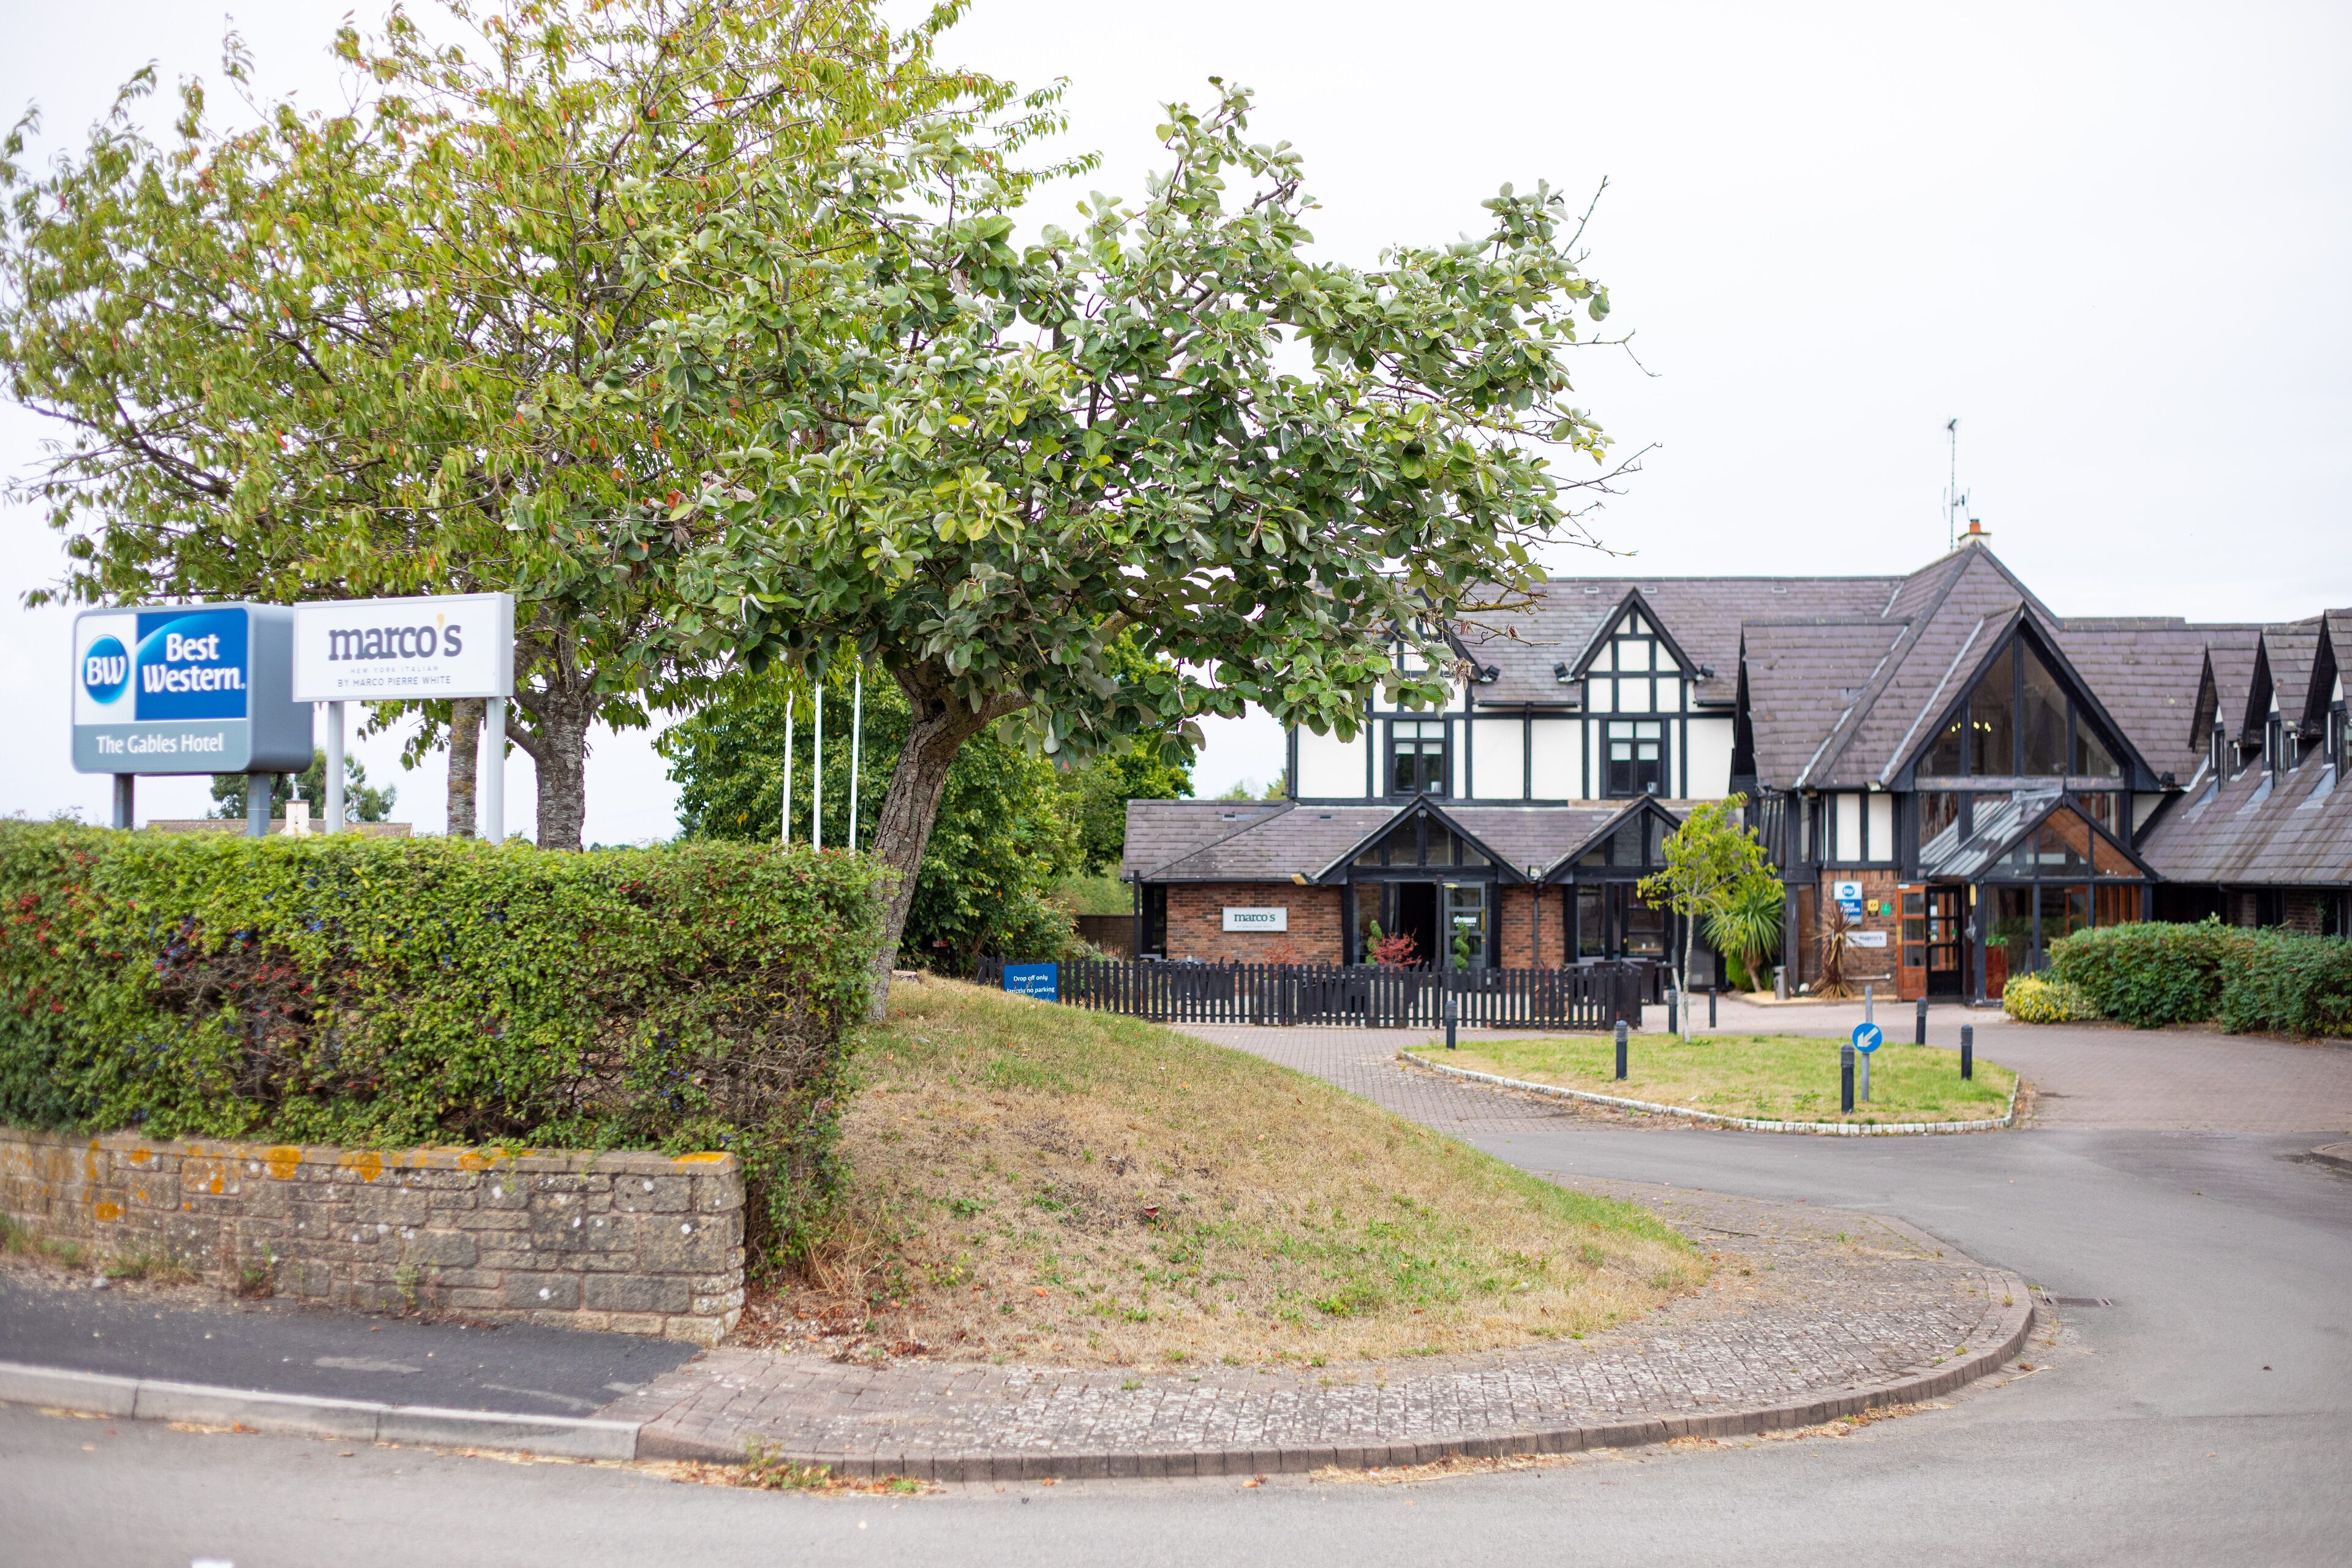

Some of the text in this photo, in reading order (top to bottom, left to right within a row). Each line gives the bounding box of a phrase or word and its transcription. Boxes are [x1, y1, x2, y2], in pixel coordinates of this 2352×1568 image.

[166, 633, 219, 662] Best
[328, 613, 462, 661] marco's
[86, 656, 125, 685] BW
[388, 677, 418, 685] PIERRE
[422, 676, 451, 684] WHITE
[96, 732, 224, 753] The Gables Hotel
[1234, 911, 1275, 922] marco's
